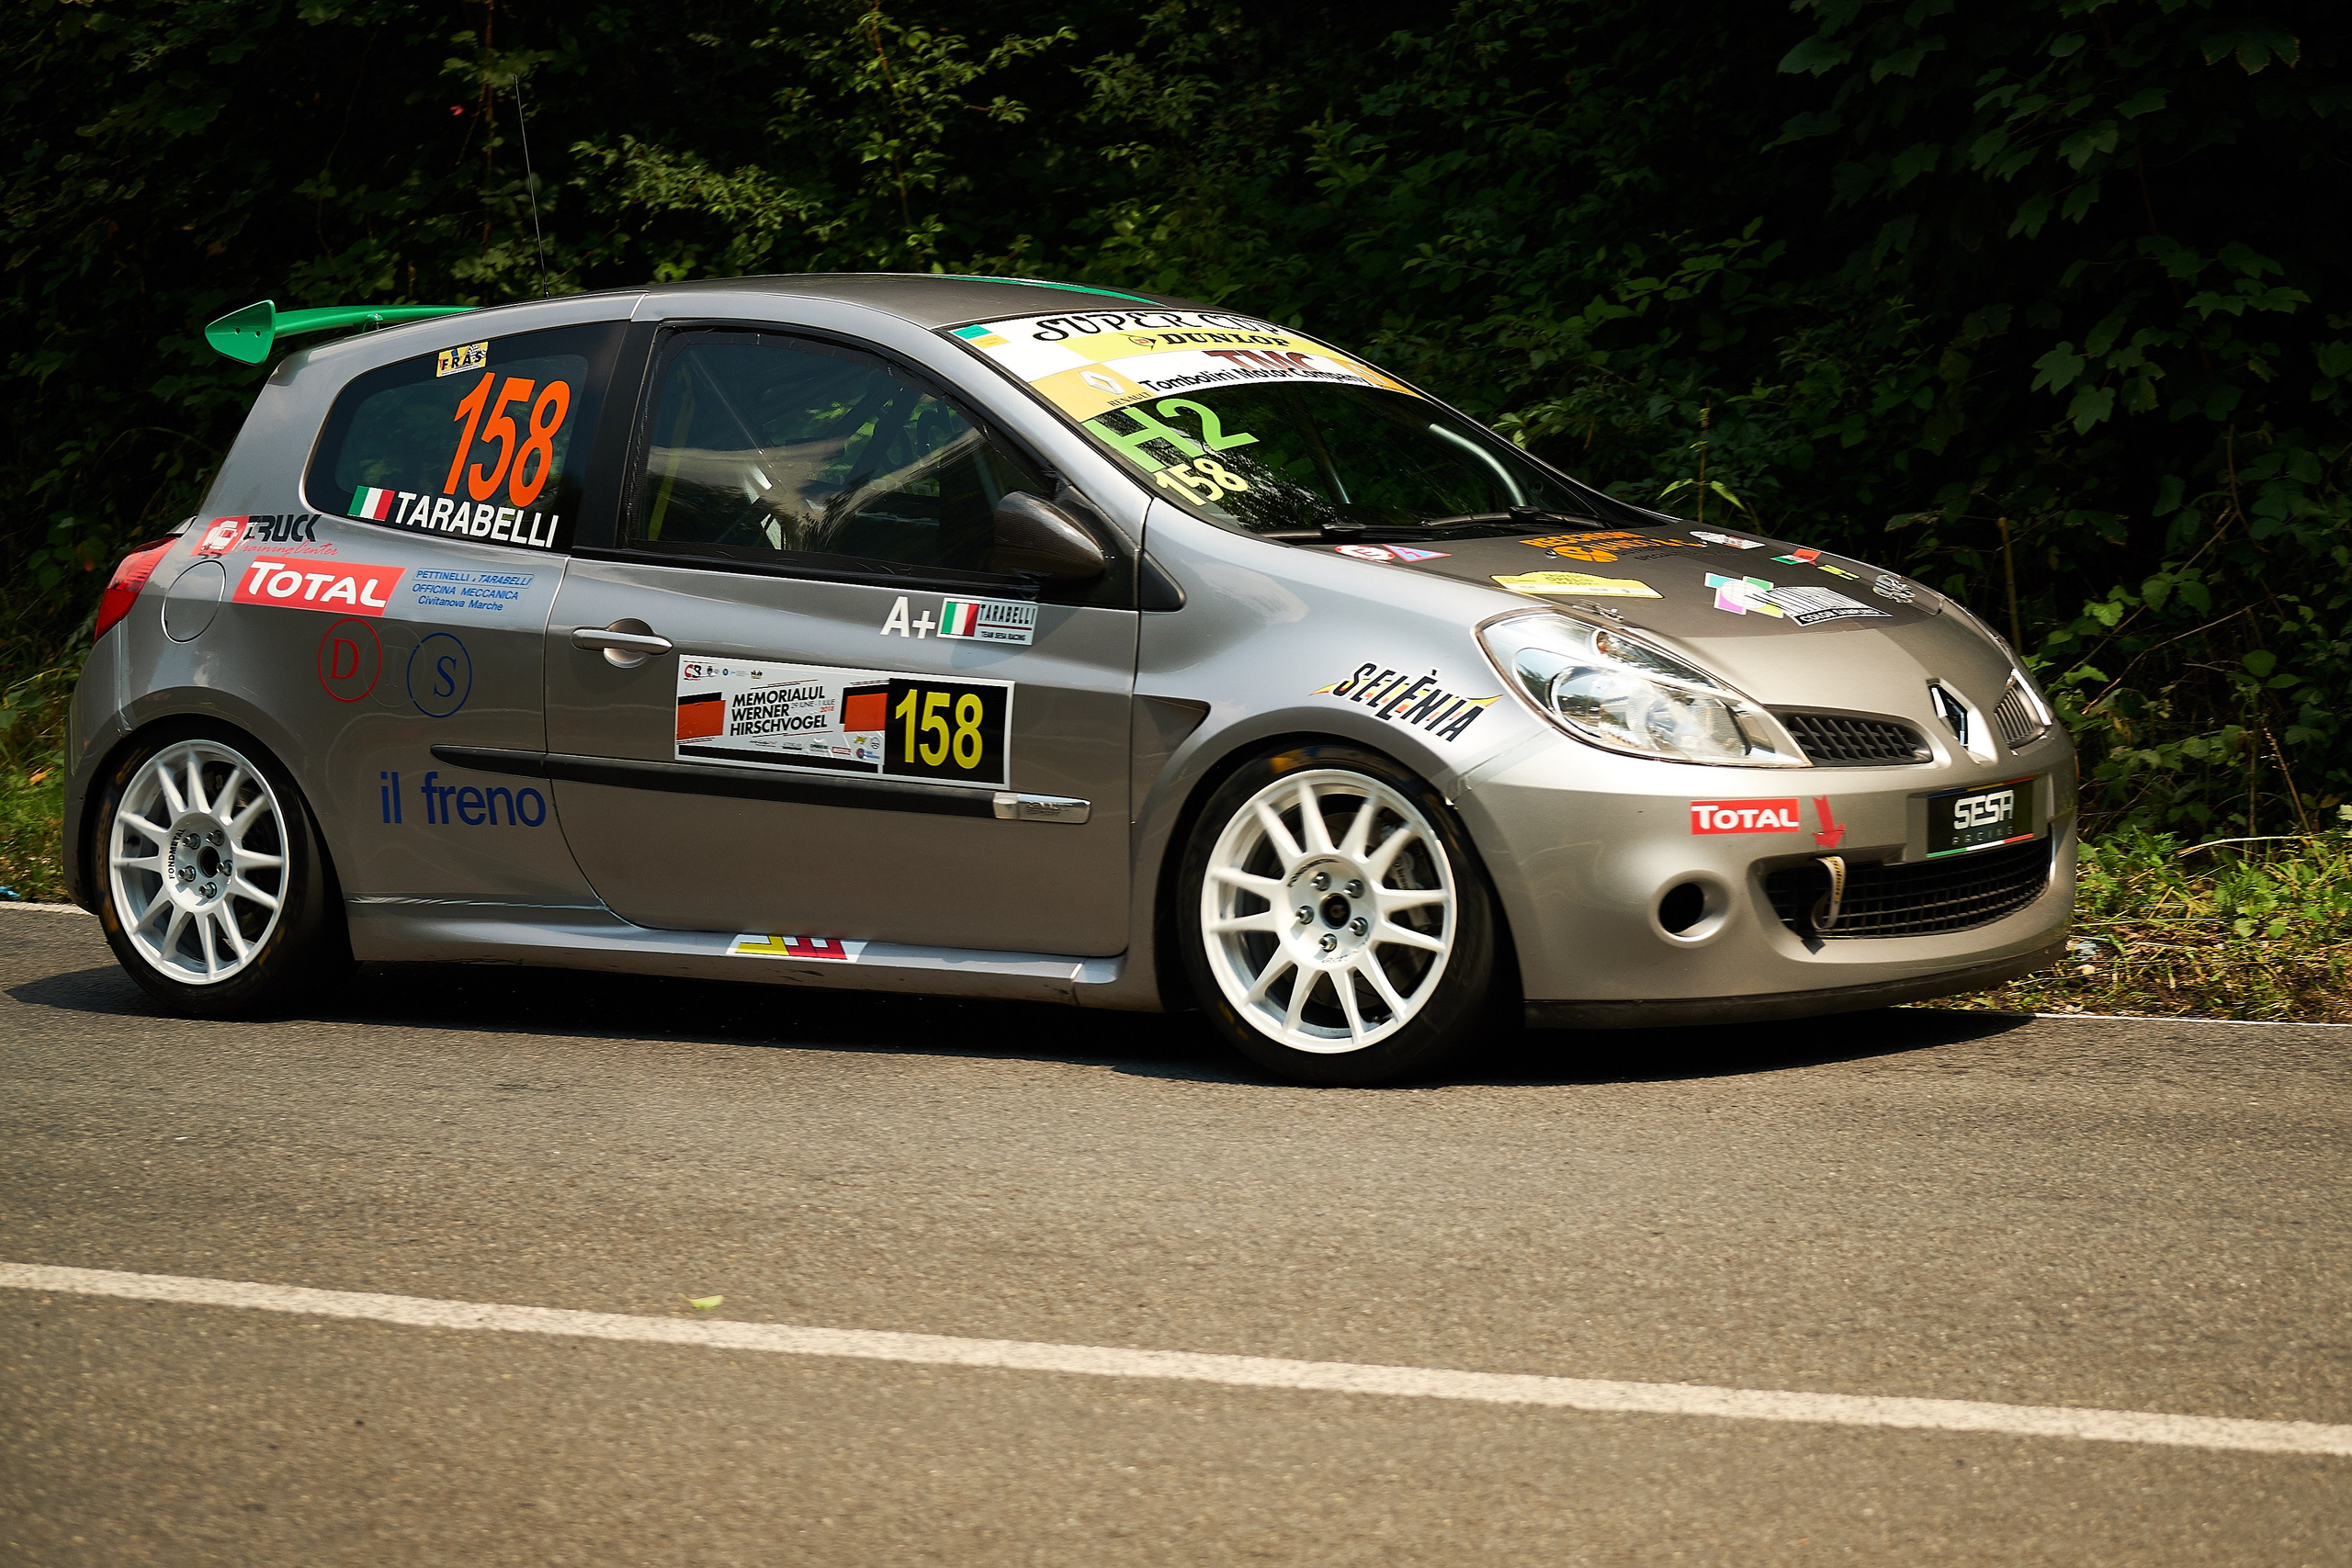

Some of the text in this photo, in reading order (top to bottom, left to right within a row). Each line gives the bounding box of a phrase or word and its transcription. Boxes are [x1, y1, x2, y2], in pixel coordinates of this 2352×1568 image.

[1033, 312, 1203, 341] SUPER
[1158, 333, 1291, 346] DUNLOP
[1202, 349, 1314, 371] TMC
[1137, 368, 1240, 392] Tombolini
[1107, 391, 1151, 407] RENAULT
[443, 372, 571, 508] 158
[1083, 398, 1260, 473] H2
[1154, 457, 1249, 506] 158
[395, 491, 560, 548] TARABELLI
[415, 570, 469, 581] PETTINELLI
[478, 574, 532, 586] TARABELLI
[413, 583, 519, 600] OFFICINA MECCANICA
[418, 595, 503, 611] Civitanova Marche
[978, 604, 1036, 625] TARABELLI
[328, 637, 360, 680] D
[433, 655, 458, 697] S
[731, 686, 826, 708] MEMORIALUL
[730, 703, 790, 722] WERNER
[729, 714, 828, 737] HIRSCHVOGEL
[895, 689, 984, 770] 158
[379, 771, 547, 828] il freno
[1953, 789, 2014, 830] SESA
[167, 829, 187, 880] FONDMETAL
